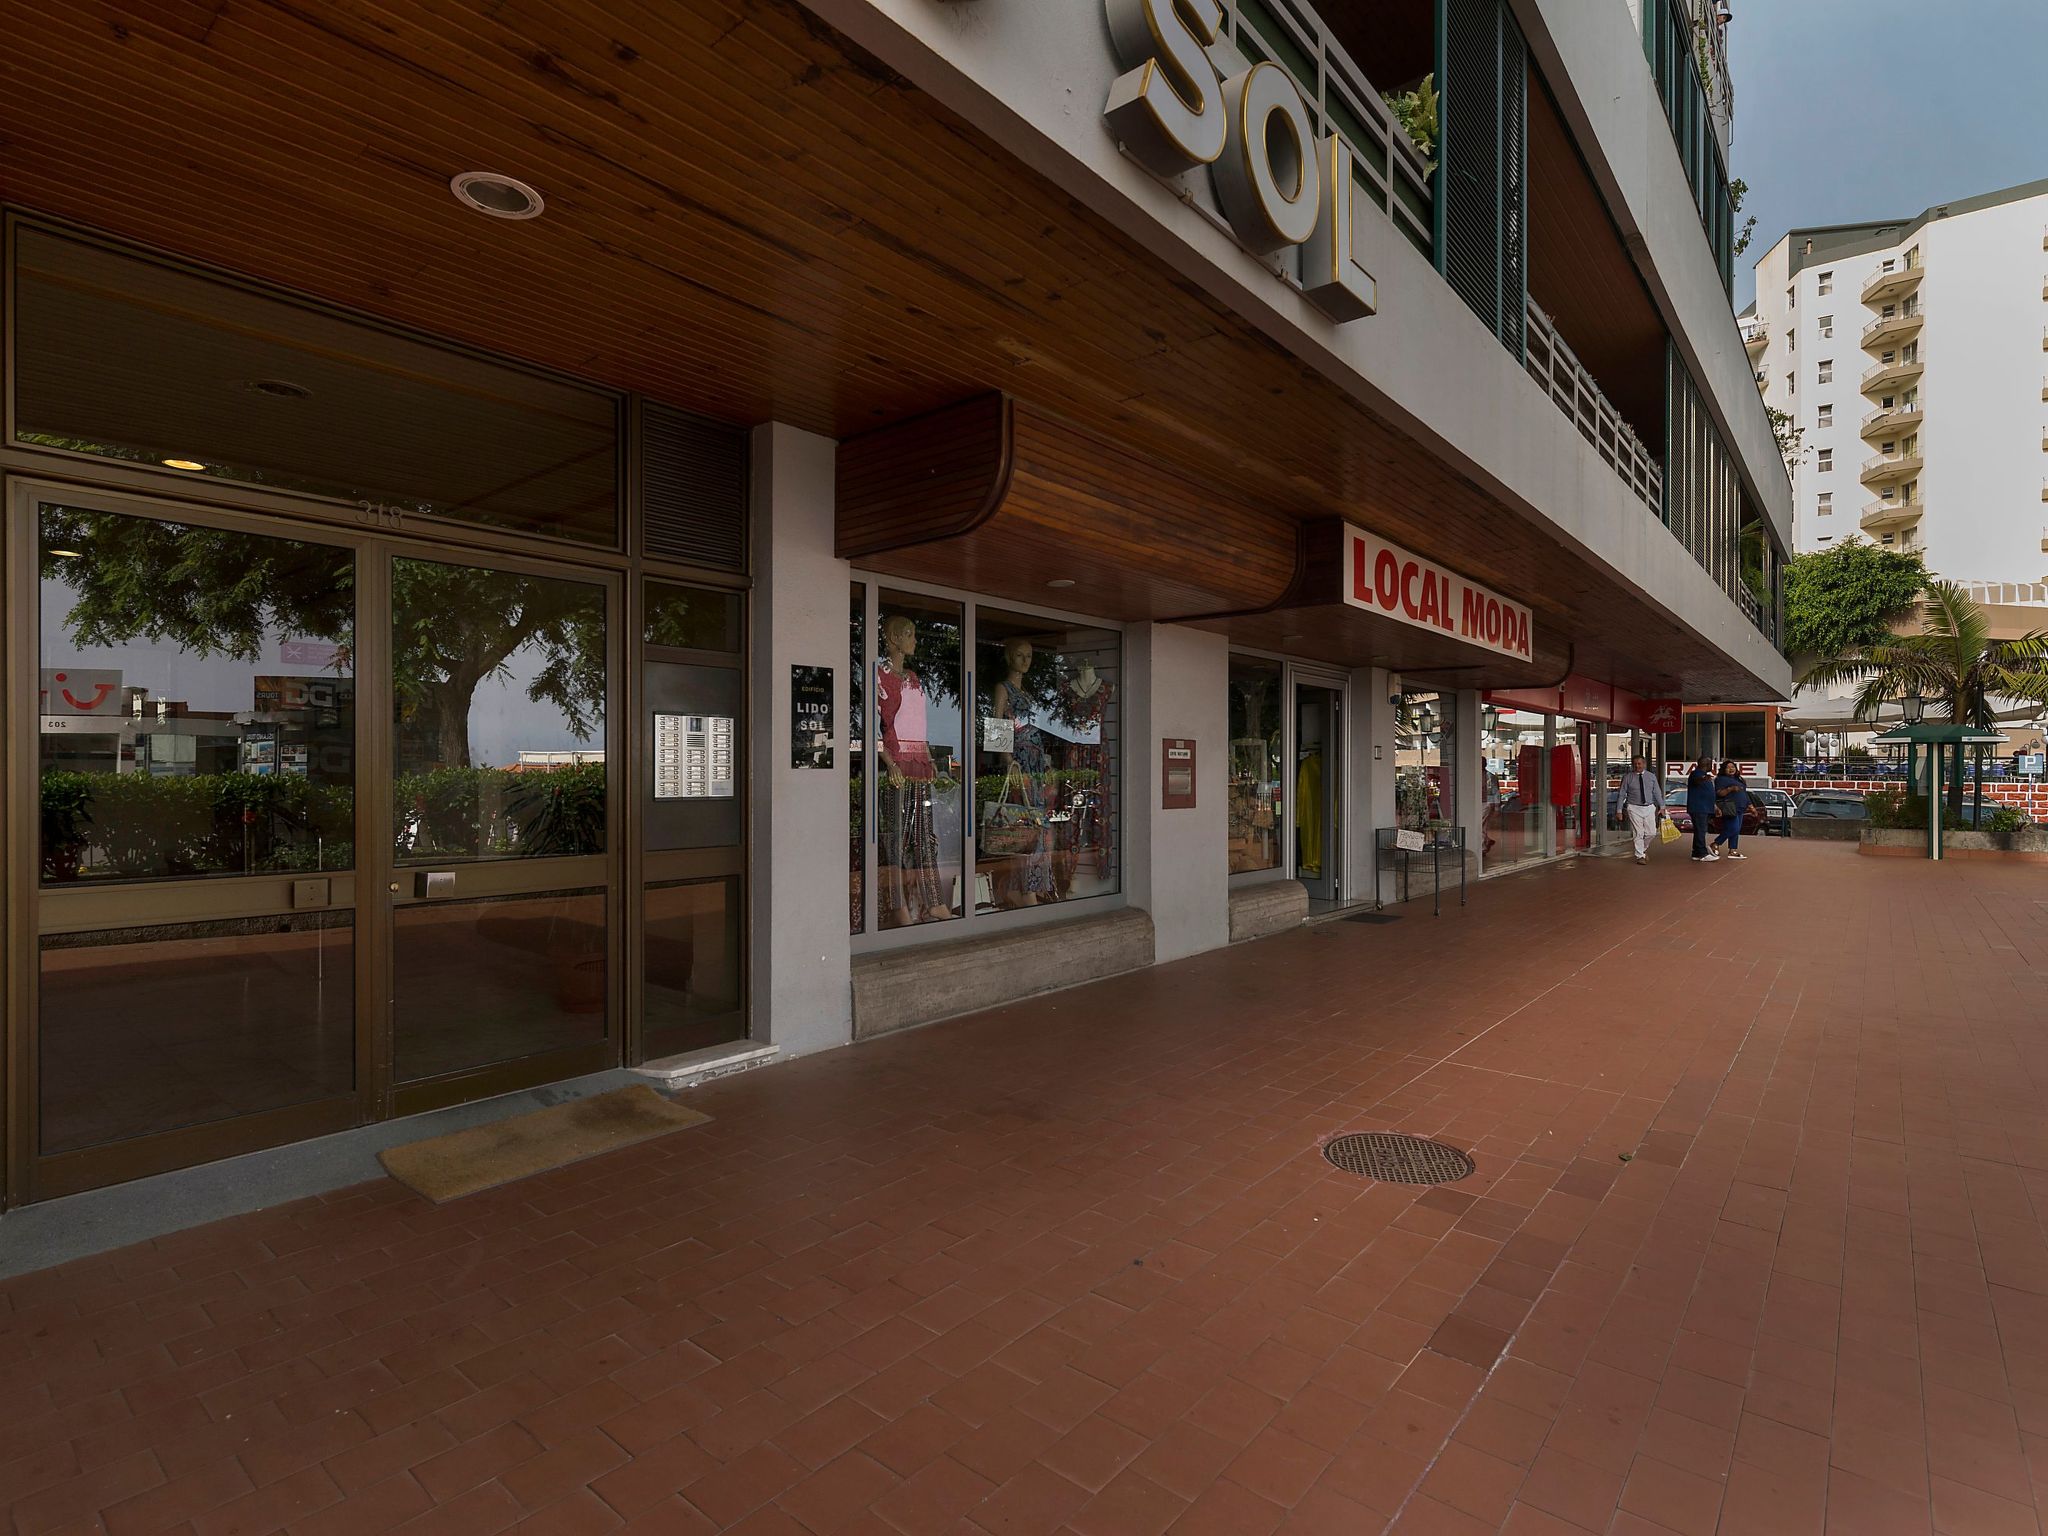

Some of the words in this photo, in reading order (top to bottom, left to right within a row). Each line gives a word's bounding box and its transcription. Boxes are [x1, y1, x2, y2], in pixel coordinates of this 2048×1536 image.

[355, 499, 402, 529] 318
[1353, 536, 1454, 632] LOCAL
[1461, 587, 1530, 656] MODA
[796, 702, 829, 714] LIDO
[800, 720, 826, 731] SOL
[2024, 756, 2036, 768] P
